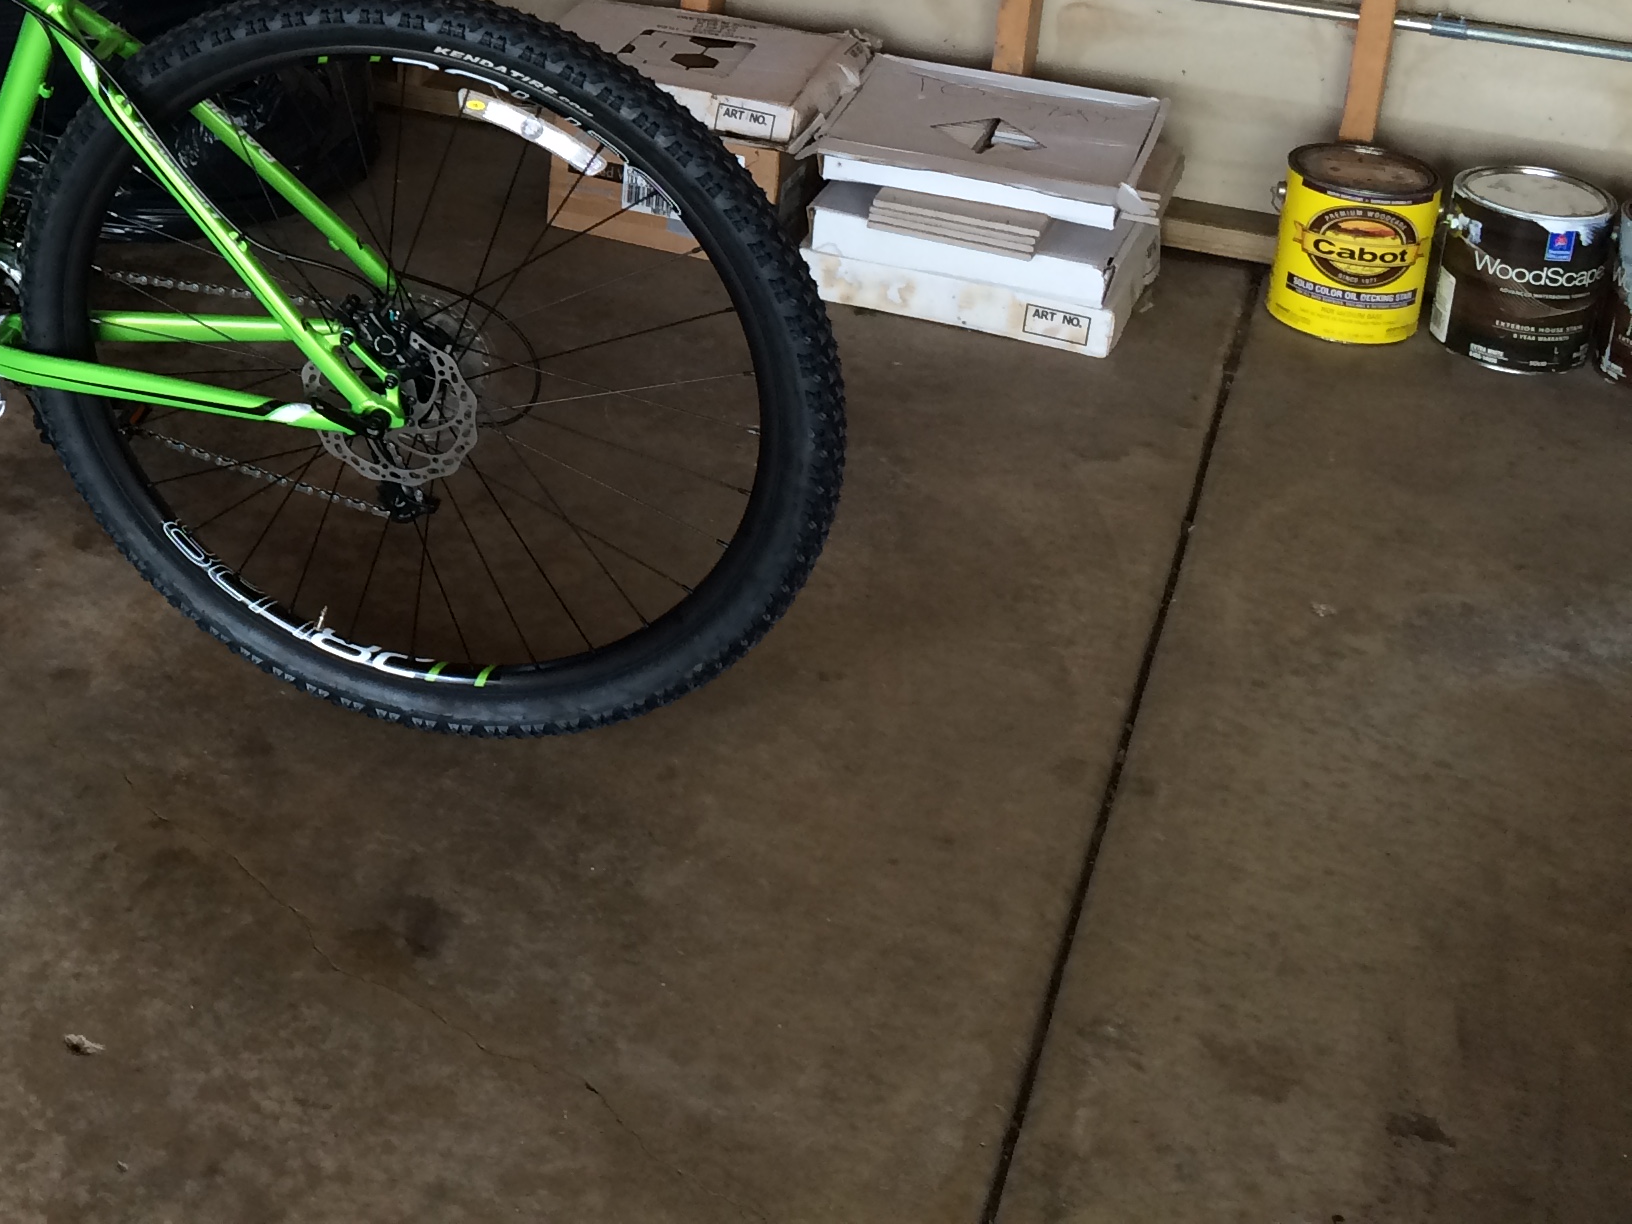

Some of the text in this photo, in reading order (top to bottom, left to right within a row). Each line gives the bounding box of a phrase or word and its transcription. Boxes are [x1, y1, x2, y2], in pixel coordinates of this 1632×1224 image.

[432, 45, 595, 119] KENDATIRE.COM
[722, 106, 768, 126] ART NO.
[1324, 209, 1363, 222] PREMIUM
[1312, 237, 1408, 264] Cabot
[1292, 276, 1314, 291] SOLID
[1315, 285, 1343, 298] COLOR
[1344, 292, 1359, 301] OIL
[1360, 293, 1394, 303] DECKING
[1032, 308, 1083, 329] ART NO.
[1495, 319, 1536, 333] EXTERIOR
